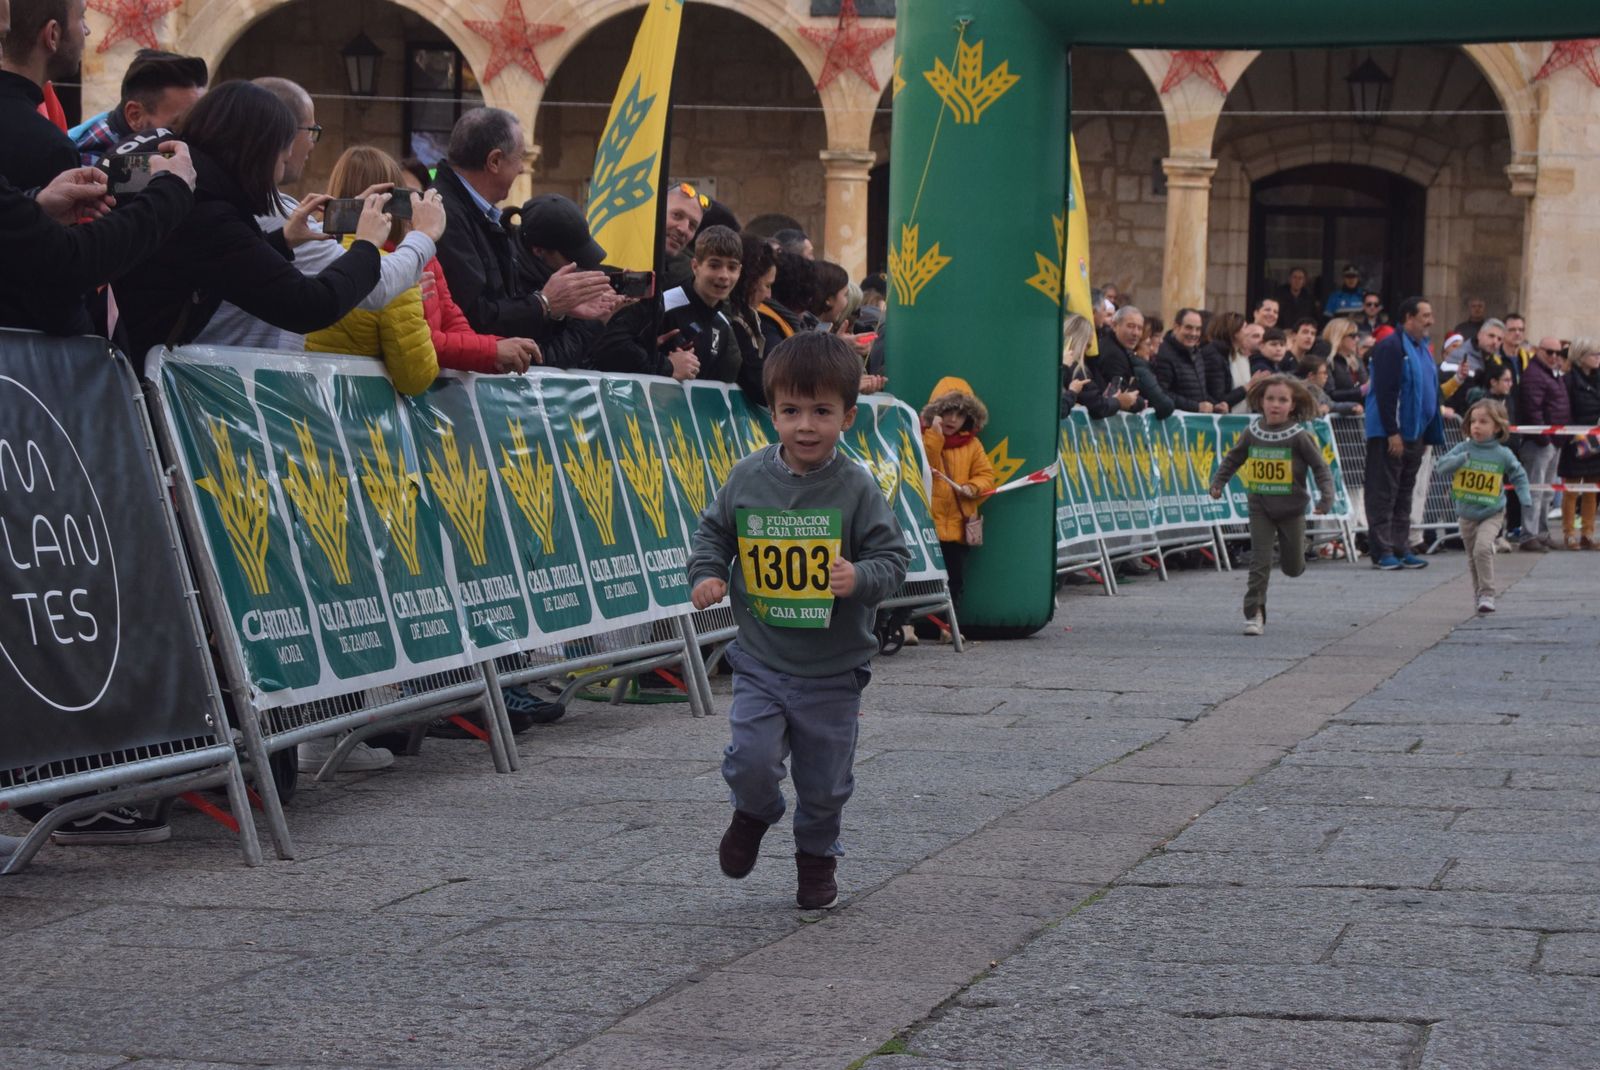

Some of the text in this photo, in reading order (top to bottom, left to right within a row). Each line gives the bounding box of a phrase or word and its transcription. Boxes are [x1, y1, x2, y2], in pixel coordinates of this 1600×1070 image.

[1251, 460, 1285, 480] 1305
[1459, 470, 1494, 492] 1304
[766, 515, 830, 527] FUNDACION
[766, 526, 831, 537] CAJA RURAL
[549, 563, 584, 590] RURAL
[748, 544, 830, 591] 1303
[480, 574, 520, 603] RURAL
[12, 588, 98, 645] TES
[318, 596, 386, 632] CAJA RURAL
[471, 610, 486, 627] DE
[770, 606, 798, 618] CAJA
[348, 630, 383, 651] ZAMORA
[409, 622, 422, 640] DE
